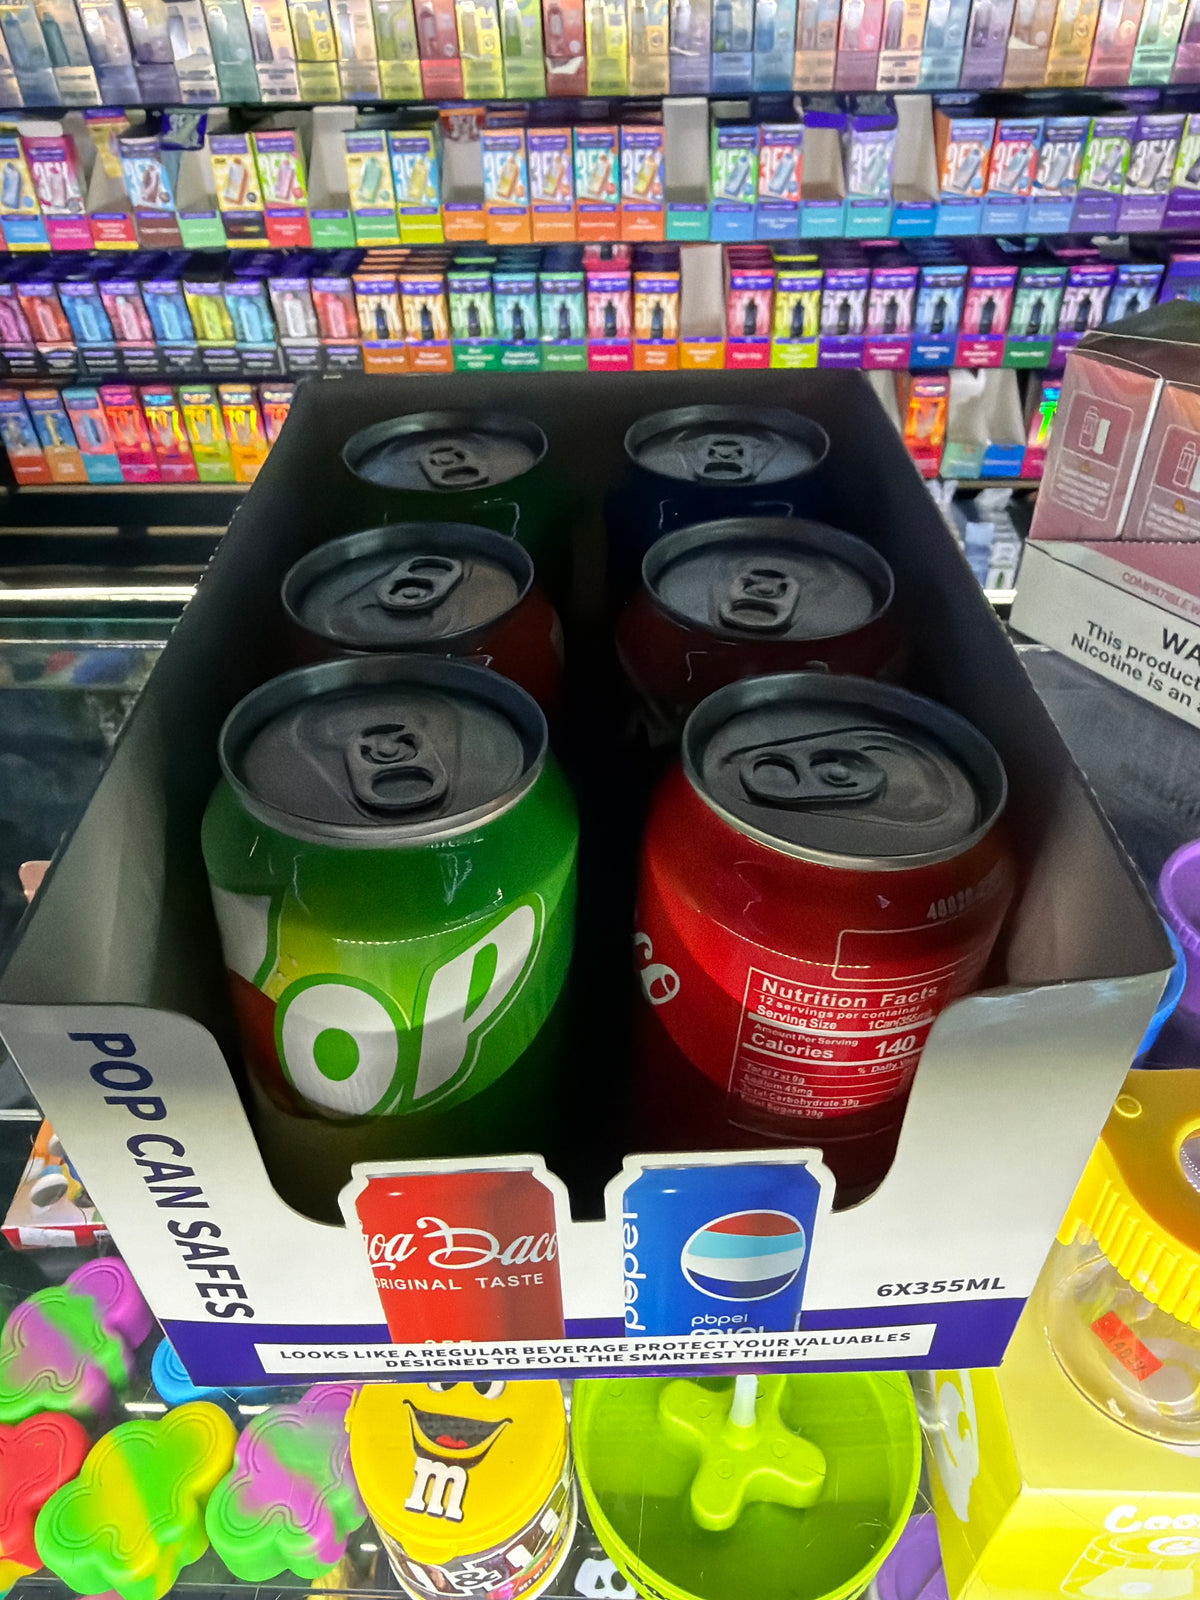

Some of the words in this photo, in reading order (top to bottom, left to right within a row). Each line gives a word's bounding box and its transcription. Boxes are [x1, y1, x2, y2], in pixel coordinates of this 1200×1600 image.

[1087, 620, 1122, 650] This
[1071, 633, 1142, 680] Nicotine
[1147, 672, 1164, 692] is
[1168, 687, 1192, 708] an
[762, 978, 866, 1008] Nutrition
[880, 986, 938, 1007] Facts
[757, 1005, 806, 1028] Serving
[809, 1018, 837, 1030] Size
[759, 995, 773, 1005] 12
[776, 1001, 833, 1018] servings
[837, 1011, 858, 1020] per
[862, 1005, 920, 1019] container
[751, 1033, 833, 1059] Calories
[874, 1035, 916, 1058] 140
[754, 1024, 796, 1040] Amount
[798, 1034, 816, 1044] Per
[818, 1038, 858, 1047] Serving
[67, 1032, 169, 1121] POP
[773, 1072, 790, 1081] Fat
[769, 1092, 839, 1107] Carbohydrate
[785, 1085, 813, 1097] 45mg
[126, 1133, 210, 1209] CAN
[167, 1219, 255, 1318] SAFES
[475, 1273, 544, 1288] TASTE
[876, 1277, 1006, 1297] 6X355ML
[280, 1350, 348, 1360] LOOKS
[354, 1349, 400, 1359] LIKE
[404, 1348, 418, 1358] A
[422, 1346, 516, 1358] REGULAR
[522, 1343, 629, 1355] BEVERAGE
[634, 1340, 729, 1351] PROTECT
[732, 1337, 790, 1348] YOUR
[793, 1332, 911, 1347] VALUABLES
[386, 1357, 489, 1368] DESIGNED
[492, 1356, 520, 1366] TO
[526, 1355, 580, 1365] FOOL
[586, 1352, 624, 1363] THE
[629, 1350, 738, 1362] SMARTEST
[740, 1347, 808, 1358] THIEF!
